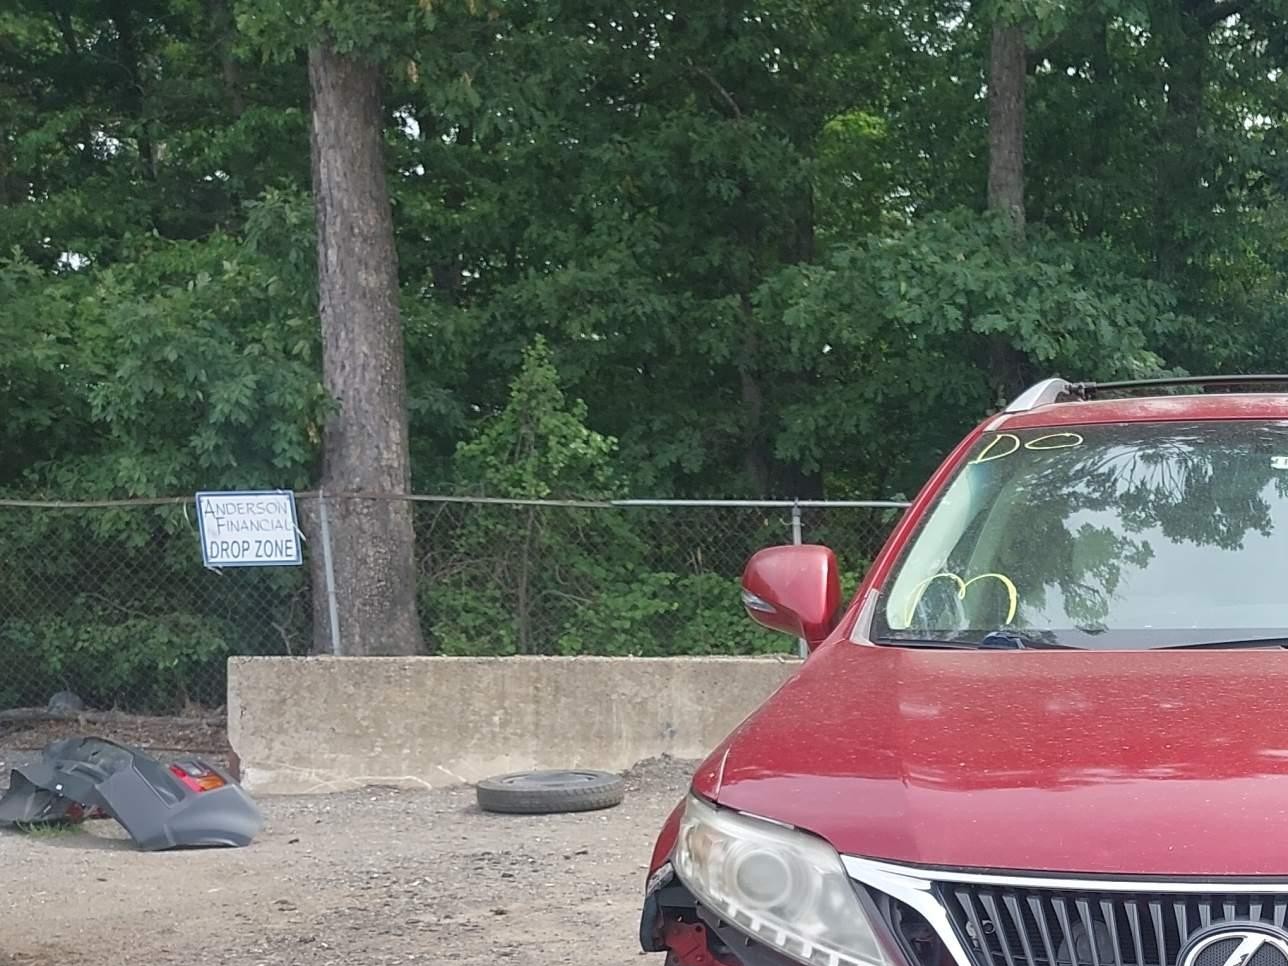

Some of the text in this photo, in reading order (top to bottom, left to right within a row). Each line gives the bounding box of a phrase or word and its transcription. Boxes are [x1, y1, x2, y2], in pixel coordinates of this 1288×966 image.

[204, 499, 288, 518] ANDERSON
[216, 517, 293, 535] FINANCIAL
[210, 539, 293, 559] DROP ZONE
